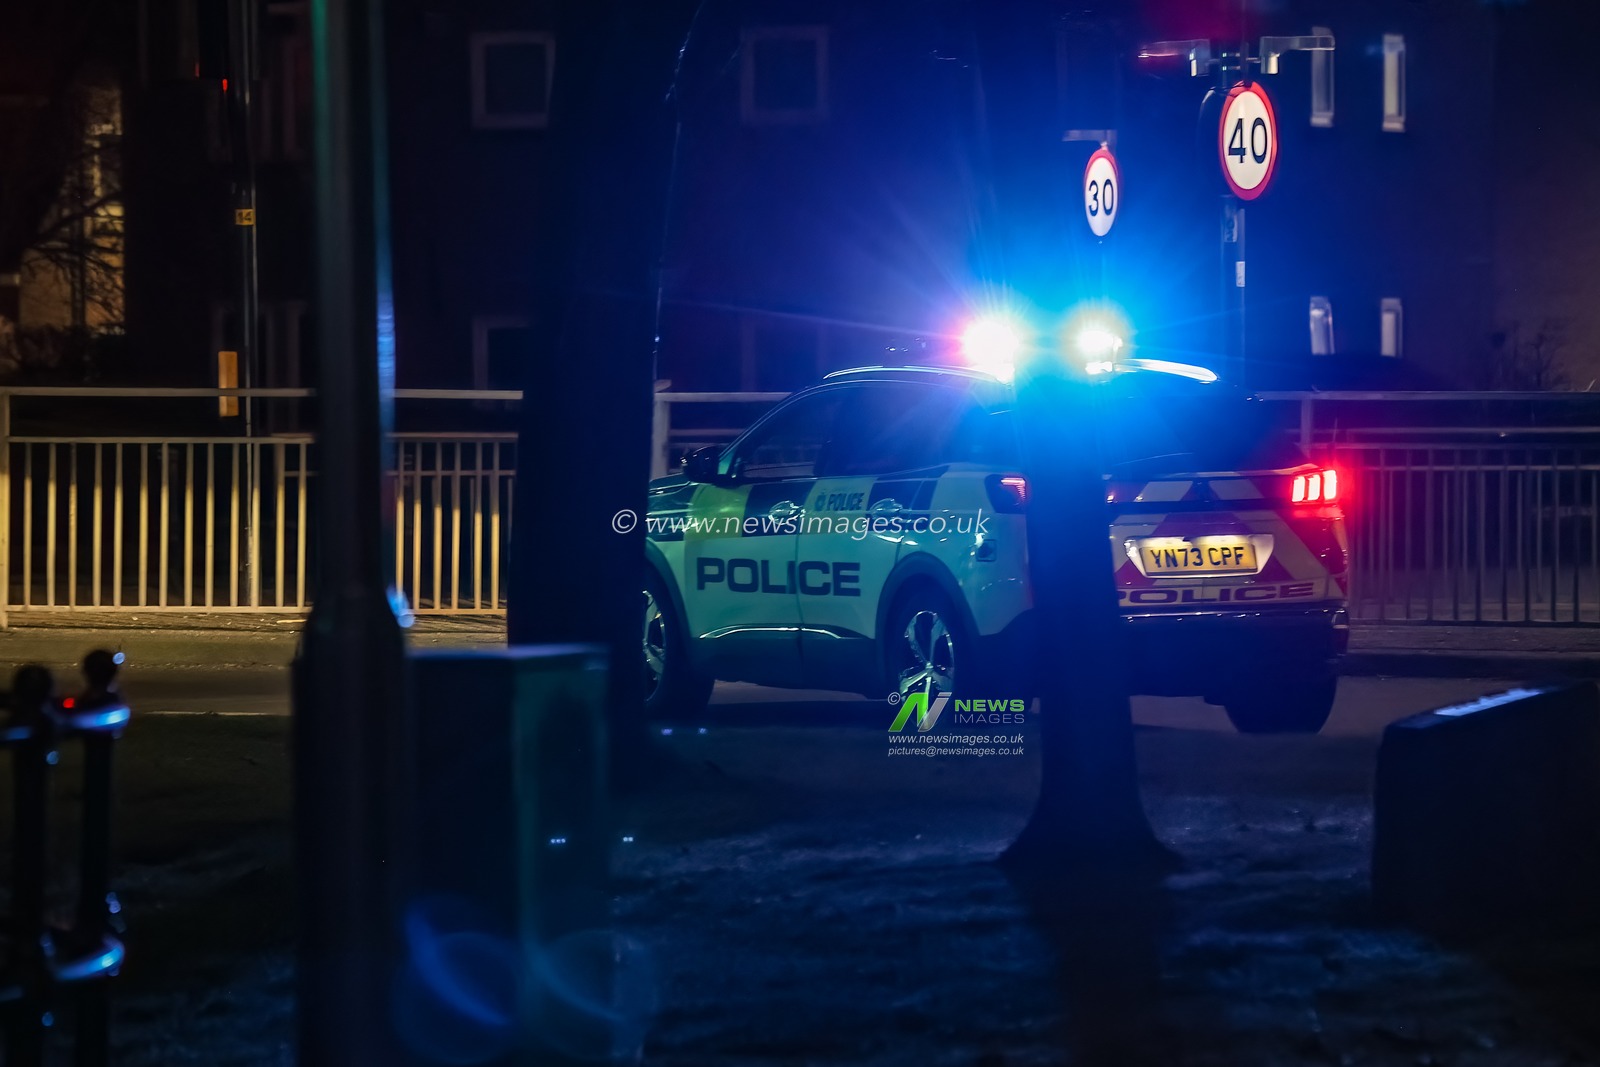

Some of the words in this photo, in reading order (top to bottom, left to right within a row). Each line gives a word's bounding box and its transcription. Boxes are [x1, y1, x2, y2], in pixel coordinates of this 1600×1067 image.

[1228, 117, 1268, 164] 40
[1088, 178, 1114, 217] 30
[238, 211, 253, 223] 14
[827, 492, 864, 511] POLICE
[1150, 546, 1204, 568] YN73
[1208, 546, 1244, 566] CPF
[696, 557, 861, 597] POLICE
